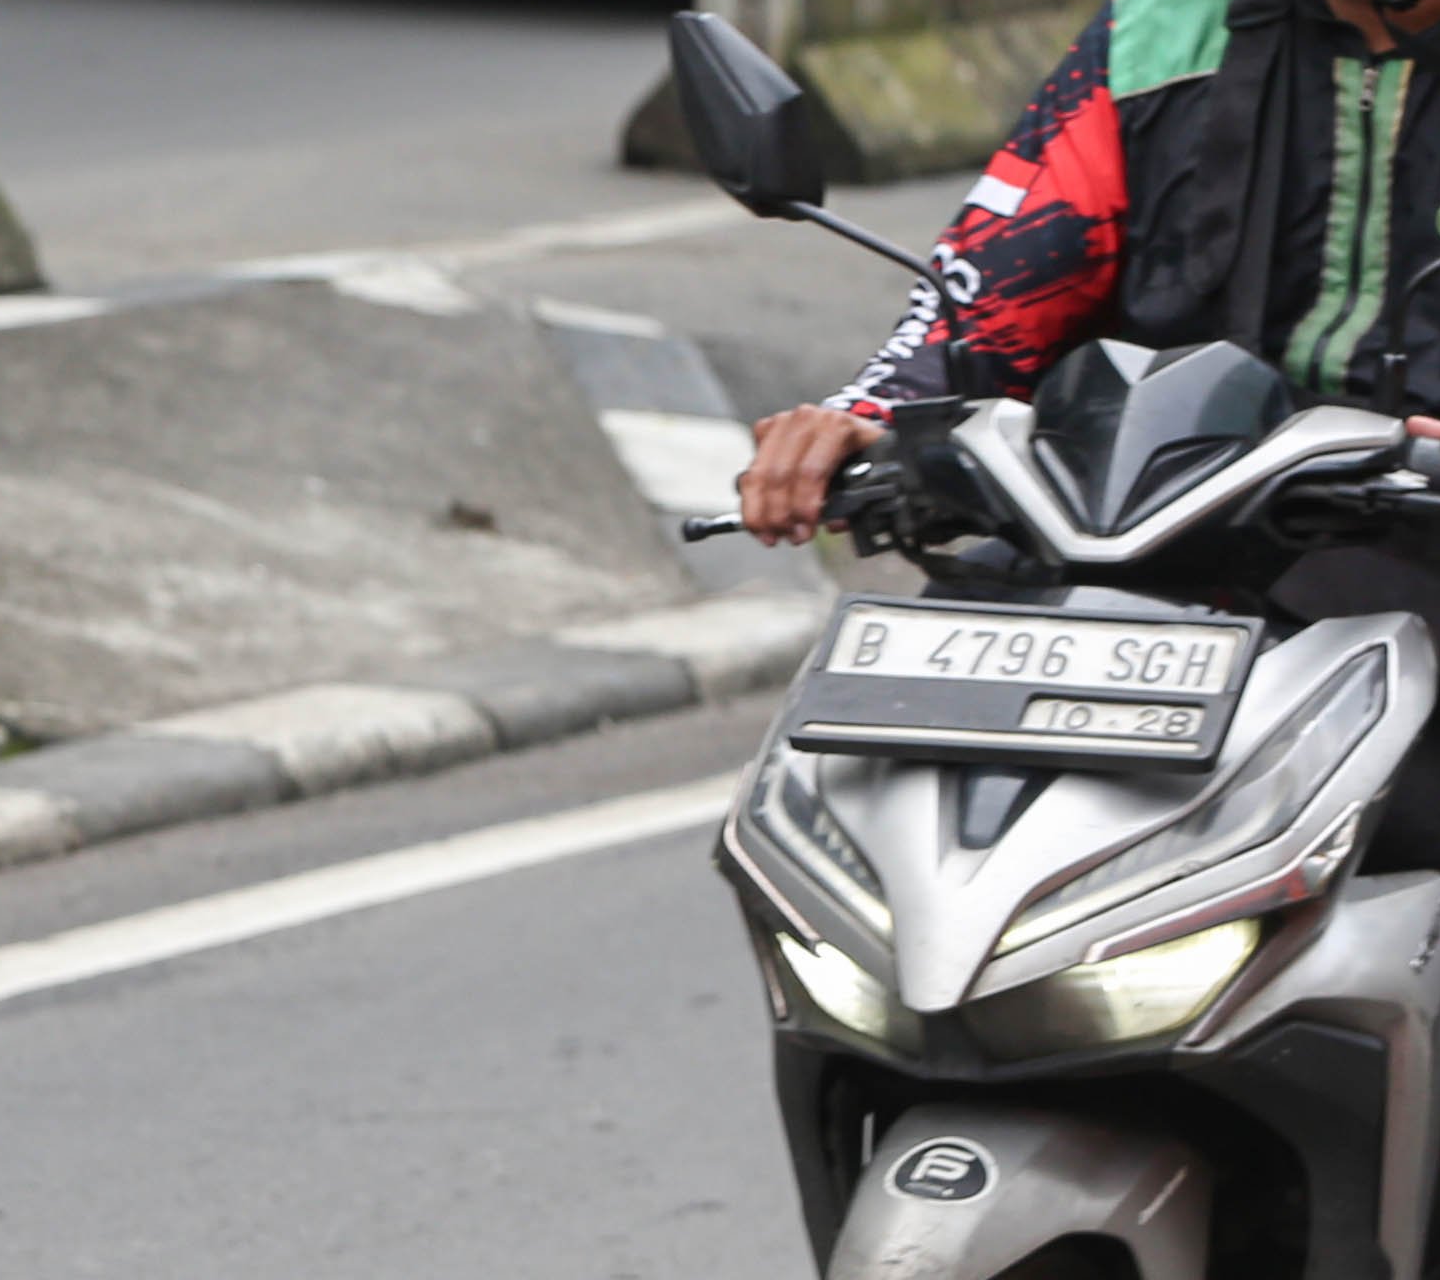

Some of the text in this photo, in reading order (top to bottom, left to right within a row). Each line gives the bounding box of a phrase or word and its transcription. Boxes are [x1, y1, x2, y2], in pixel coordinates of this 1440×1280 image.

[853, 622, 1218, 688] B 4796 SGH
